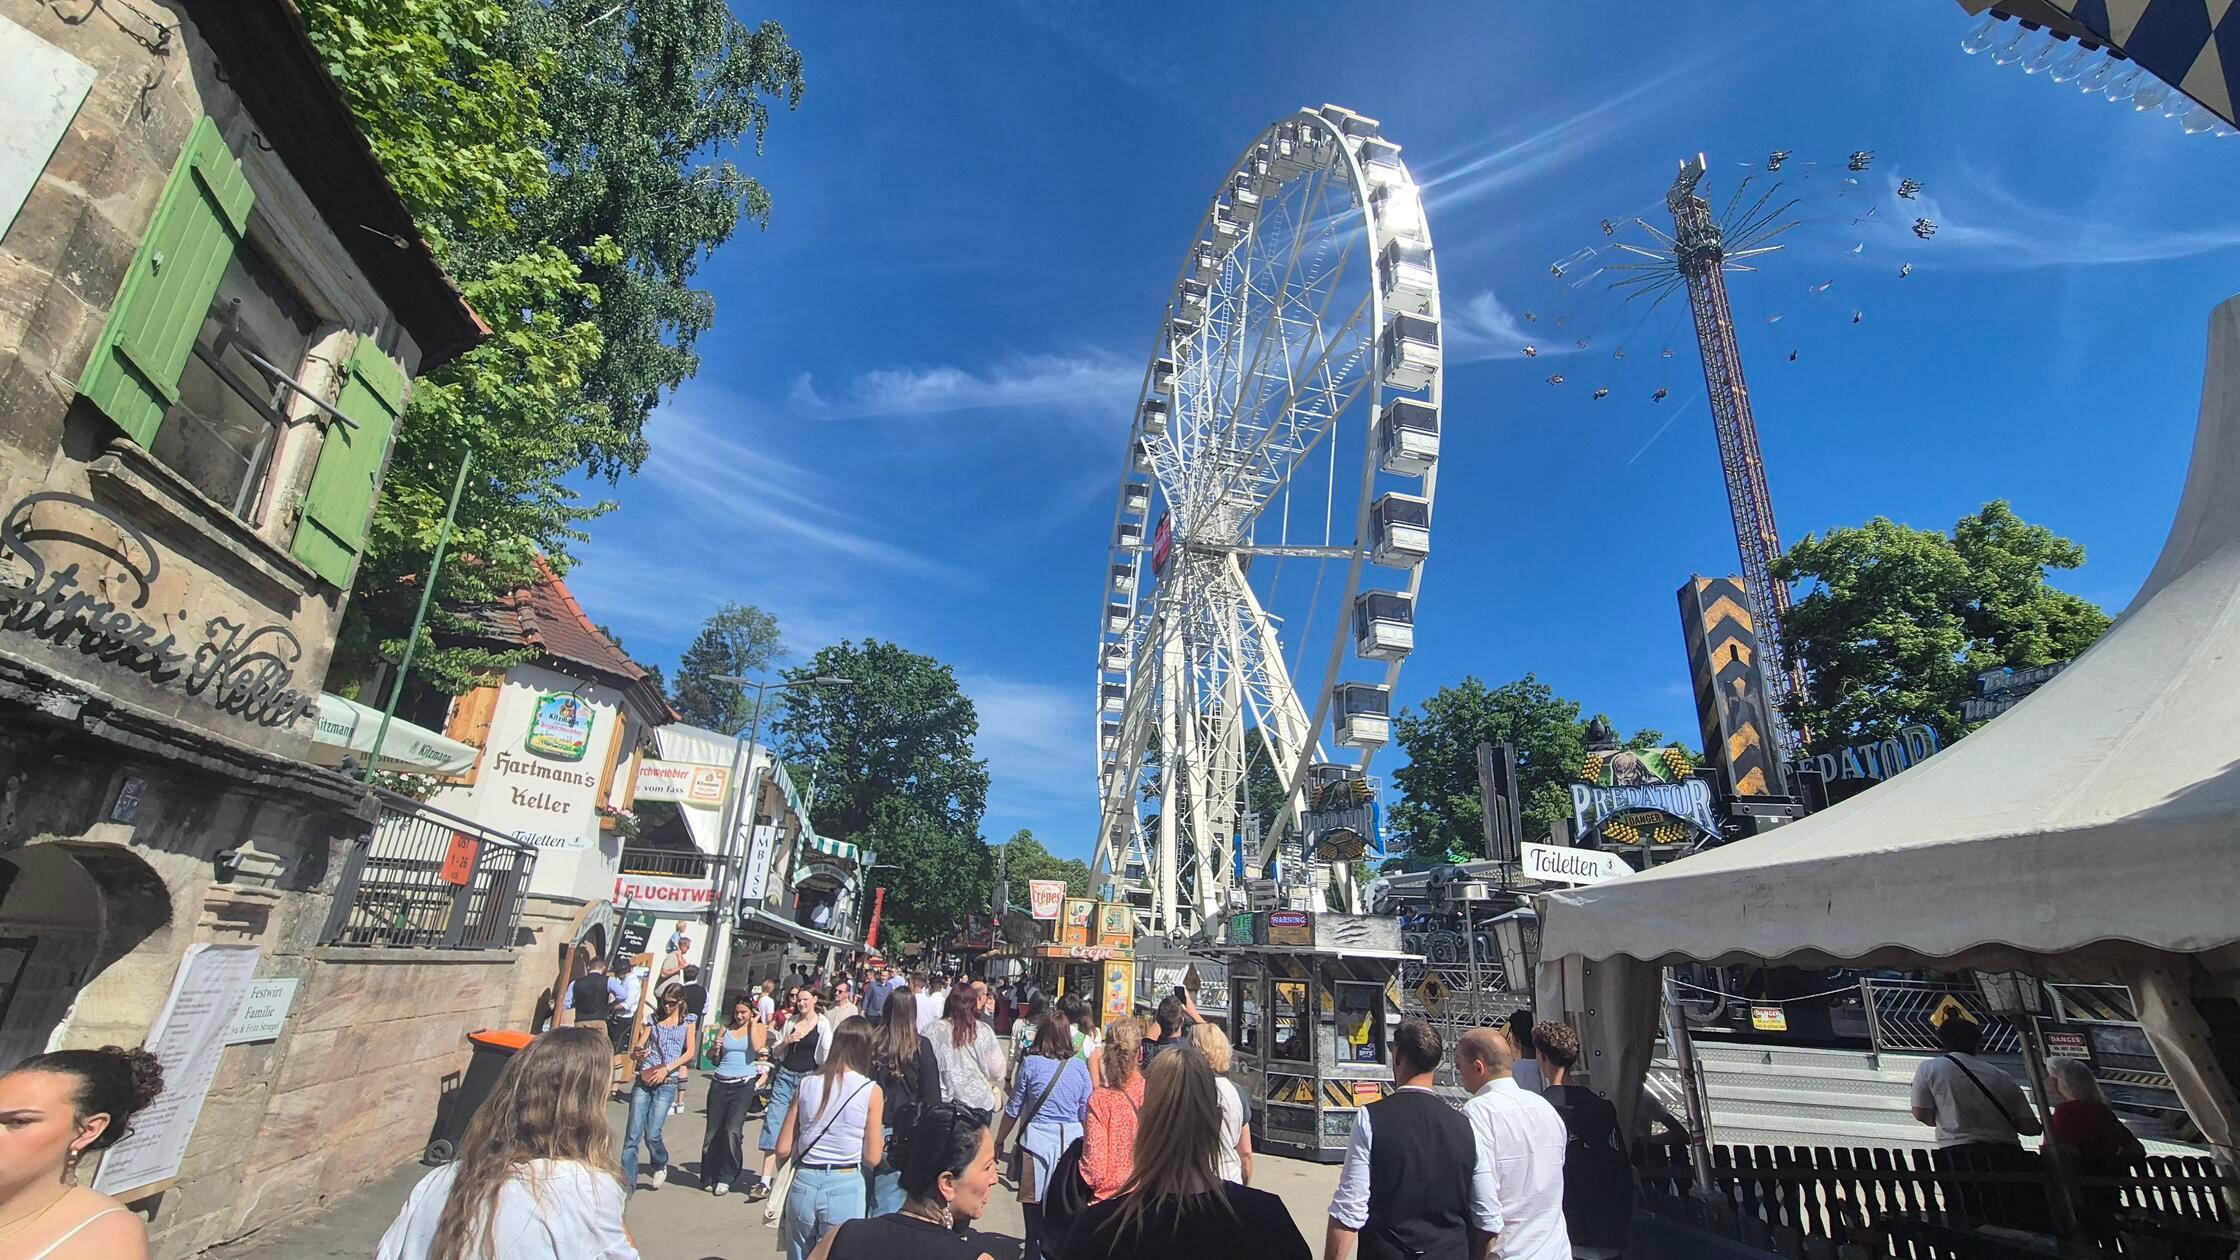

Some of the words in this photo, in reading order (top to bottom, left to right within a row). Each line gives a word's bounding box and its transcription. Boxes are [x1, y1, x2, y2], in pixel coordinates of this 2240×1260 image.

[193, 616, 318, 728] Keller
[418, 744, 451, 762] Kitzmann
[493, 751, 596, 788] Hartmann's
[511, 786, 571, 814] Keller
[644, 785, 663, 793] vom
[1571, 777, 1724, 843] PREDATOR
[1628, 813, 1662, 824] DANGER
[511, 831, 565, 848] Toiletten
[1302, 803, 1378, 858] PREDATOR
[752, 827, 769, 897] IMBISS
[1530, 848, 1599, 878] Toiletten
[250, 986, 283, 999] Festwirt
[244, 1005, 275, 1019] Familie
